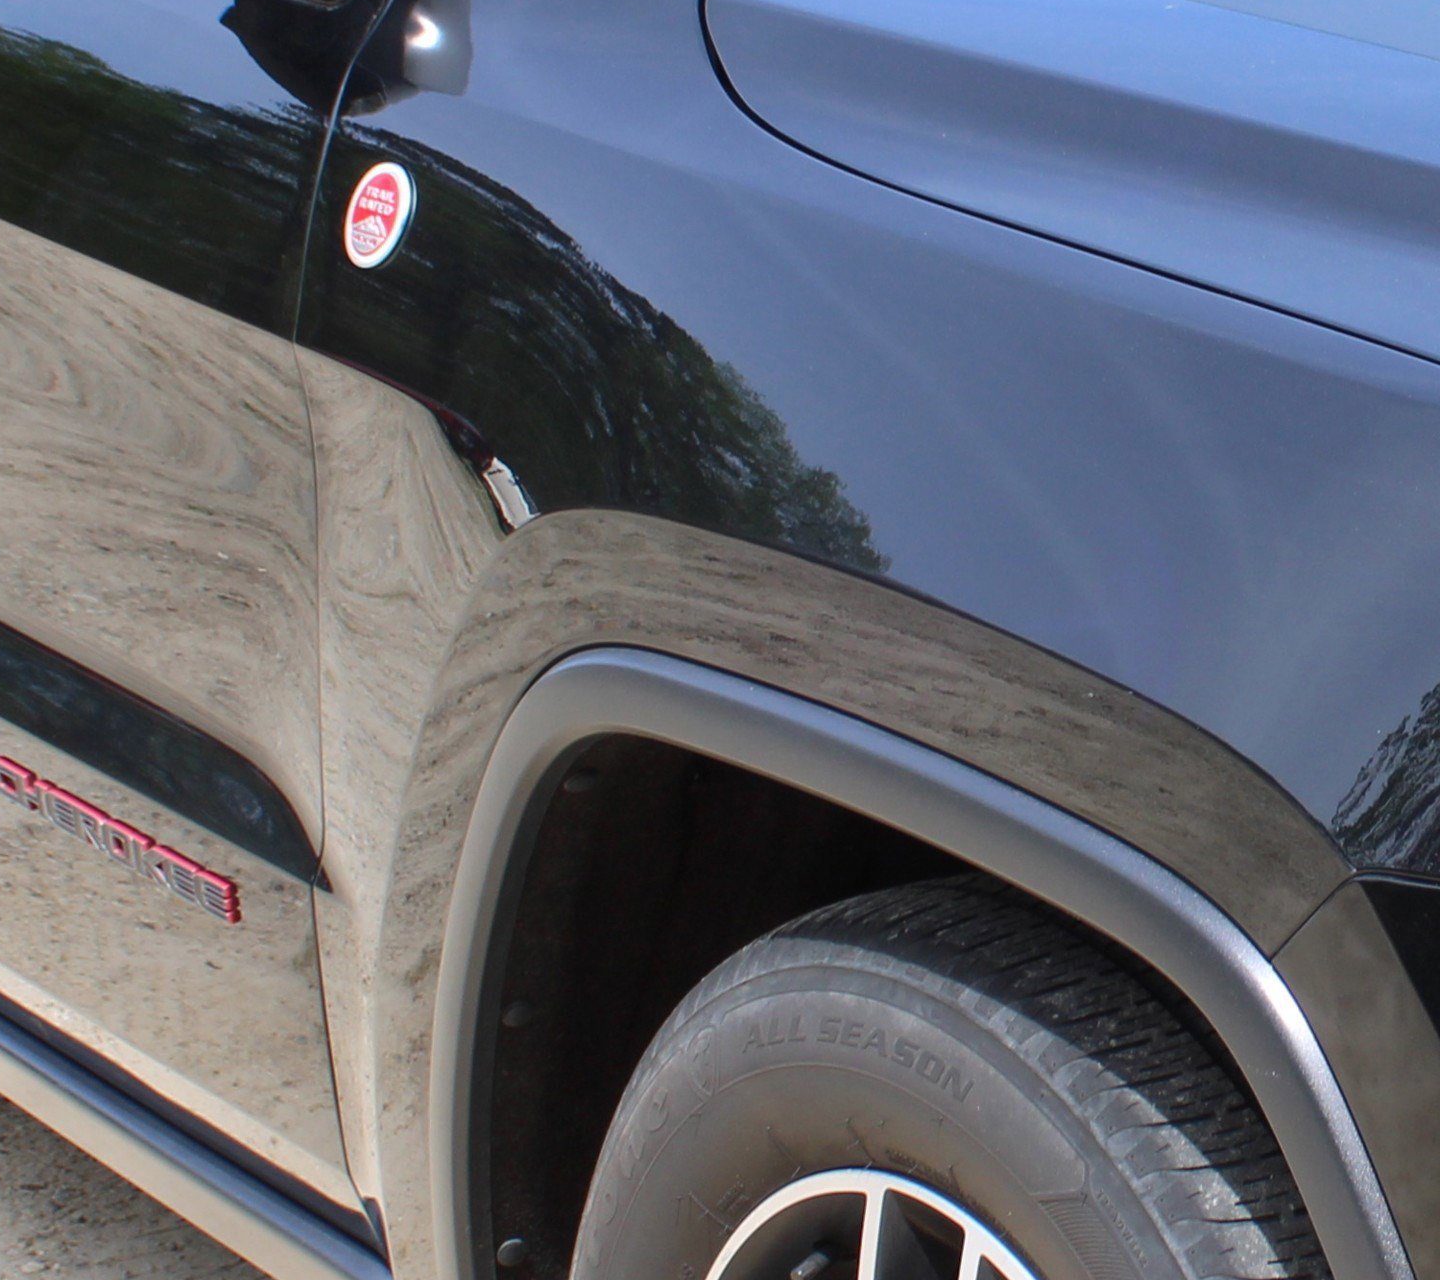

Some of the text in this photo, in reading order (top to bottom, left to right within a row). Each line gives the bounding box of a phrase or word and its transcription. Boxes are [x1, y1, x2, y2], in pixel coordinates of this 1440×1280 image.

[366, 186, 395, 203] TRAIL
[359, 197, 395, 216] RATED
[742, 1015, 808, 1055] ALL
[816, 1015, 975, 1104] SEASON
